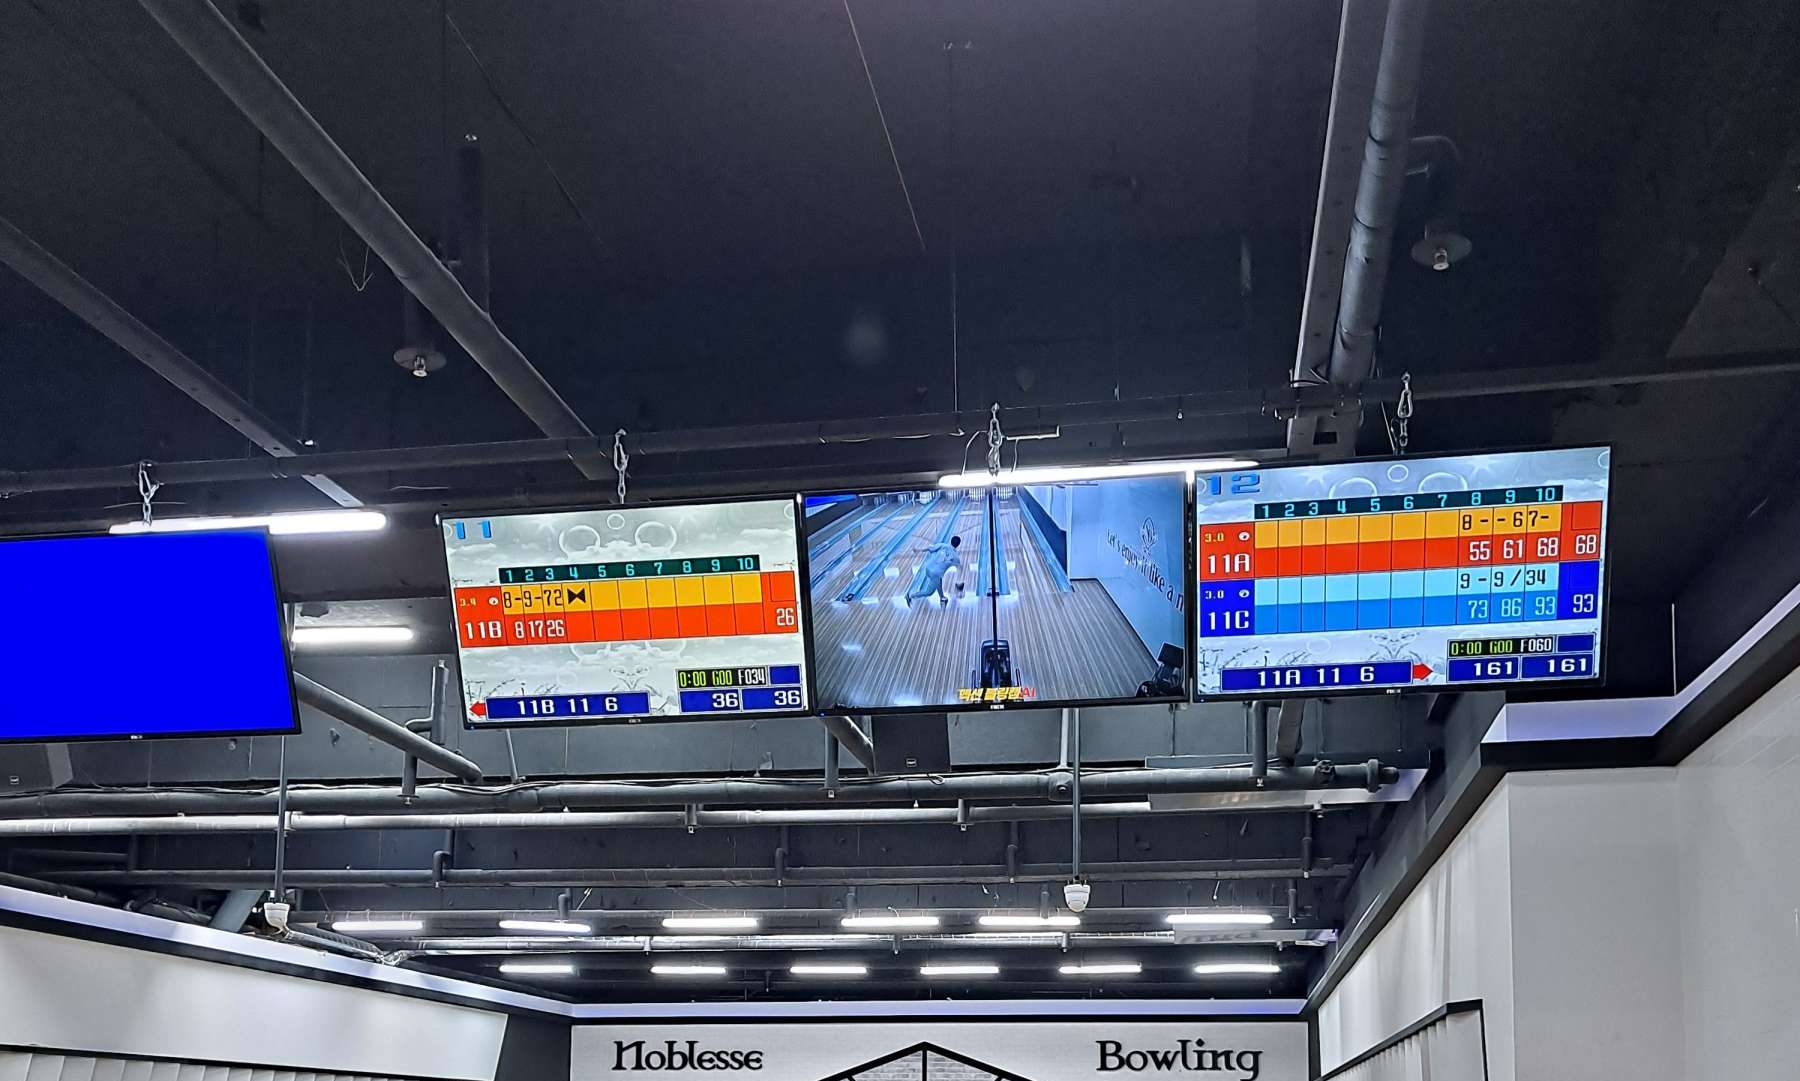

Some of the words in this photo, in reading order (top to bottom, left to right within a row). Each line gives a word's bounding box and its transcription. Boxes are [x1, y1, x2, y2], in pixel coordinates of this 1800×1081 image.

[1207, 473, 1261, 496] 12
[1262, 505, 1270, 518] 1
[1284, 503, 1295, 517] 2
[1308, 502, 1319, 515] 3
[1337, 500, 1347, 514] 4
[1370, 498, 1381, 512] 5
[1403, 496, 1414, 509] 6
[1437, 494, 1448, 507] 7
[1471, 492, 1482, 506] 8
[1505, 490, 1516, 504] 9
[1535, 487, 1556, 502] 10
[452, 519, 492, 540] 11
[1207, 553, 1250, 575] 11A
[1469, 541, 1491, 561] 55
[1503, 539, 1524, 559] 61
[1537, 537, 1559, 557] 68
[1575, 534, 1597, 555] 68
[505, 569, 513, 583] 1
[524, 568, 535, 582] 2
[545, 567, 555, 580] 3
[569, 566, 579, 579] 4
[597, 565, 607, 578] 5
[625, 563, 635, 577] 6
[653, 562, 663, 575] 7
[682, 560, 693, 574] 8
[711, 559, 721, 572] 9
[736, 557, 754, 571] 10
[1166, 585, 1174, 601] a
[1208, 610, 1250, 631] 11C
[1468, 599, 1489, 619] 73
[1501, 598, 1522, 618] 86
[1535, 596, 1556, 616] 93
[1572, 593, 1595, 614] 93
[465, 620, 502, 640] 11B
[514, 621, 525, 640] 8
[528, 620, 545, 638] 17
[546, 619, 566, 638] 26
[775, 607, 795, 626] 26
[1451, 640, 1483, 656] 0:00
[1257, 669, 1301, 687] 11A
[1316, 667, 1341, 685] 11
[1359, 666, 1375, 683] 6
[1473, 661, 1513, 677] 161
[1547, 657, 1588, 674] 161
[679, 671, 707, 688] 0:00
[516, 699, 555, 716] 11B
[567, 698, 590, 714] 11
[605, 696, 619, 713] 6
[711, 692, 739, 709] 36
[773, 689, 801, 706] 36
[611, 1039, 764, 1071] Noblesse
